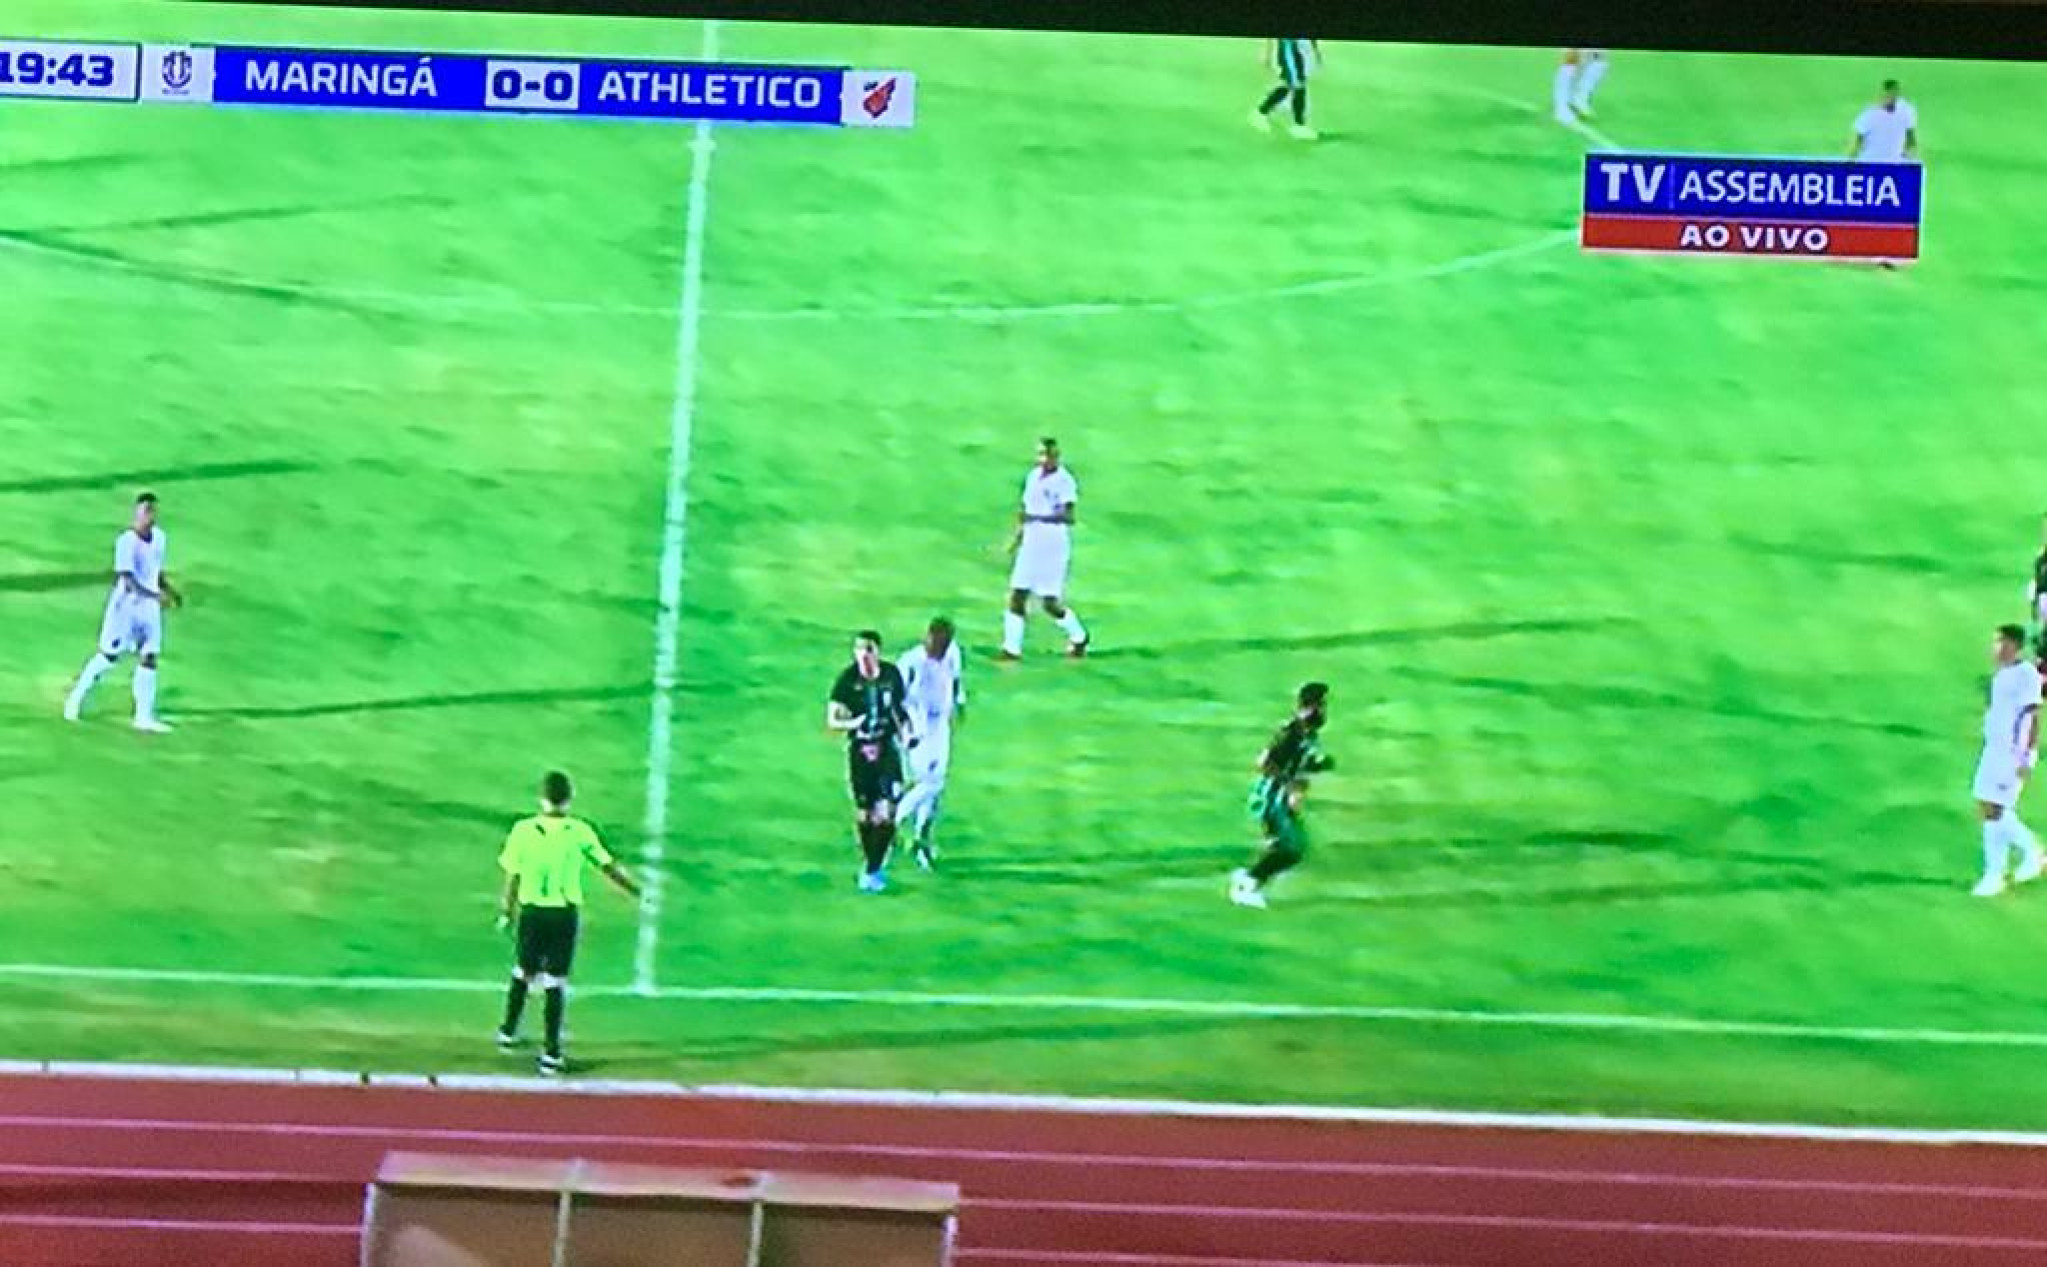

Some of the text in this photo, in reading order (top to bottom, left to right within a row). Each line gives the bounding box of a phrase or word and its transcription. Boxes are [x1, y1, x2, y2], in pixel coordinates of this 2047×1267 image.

[0, 51, 822, 109] 19:43 MARINGÁ 0-0 ATHLETICO
[1600, 163, 1901, 207] TV ASSEMBLEIA
[1680, 224, 1829, 251] AO VIVO
